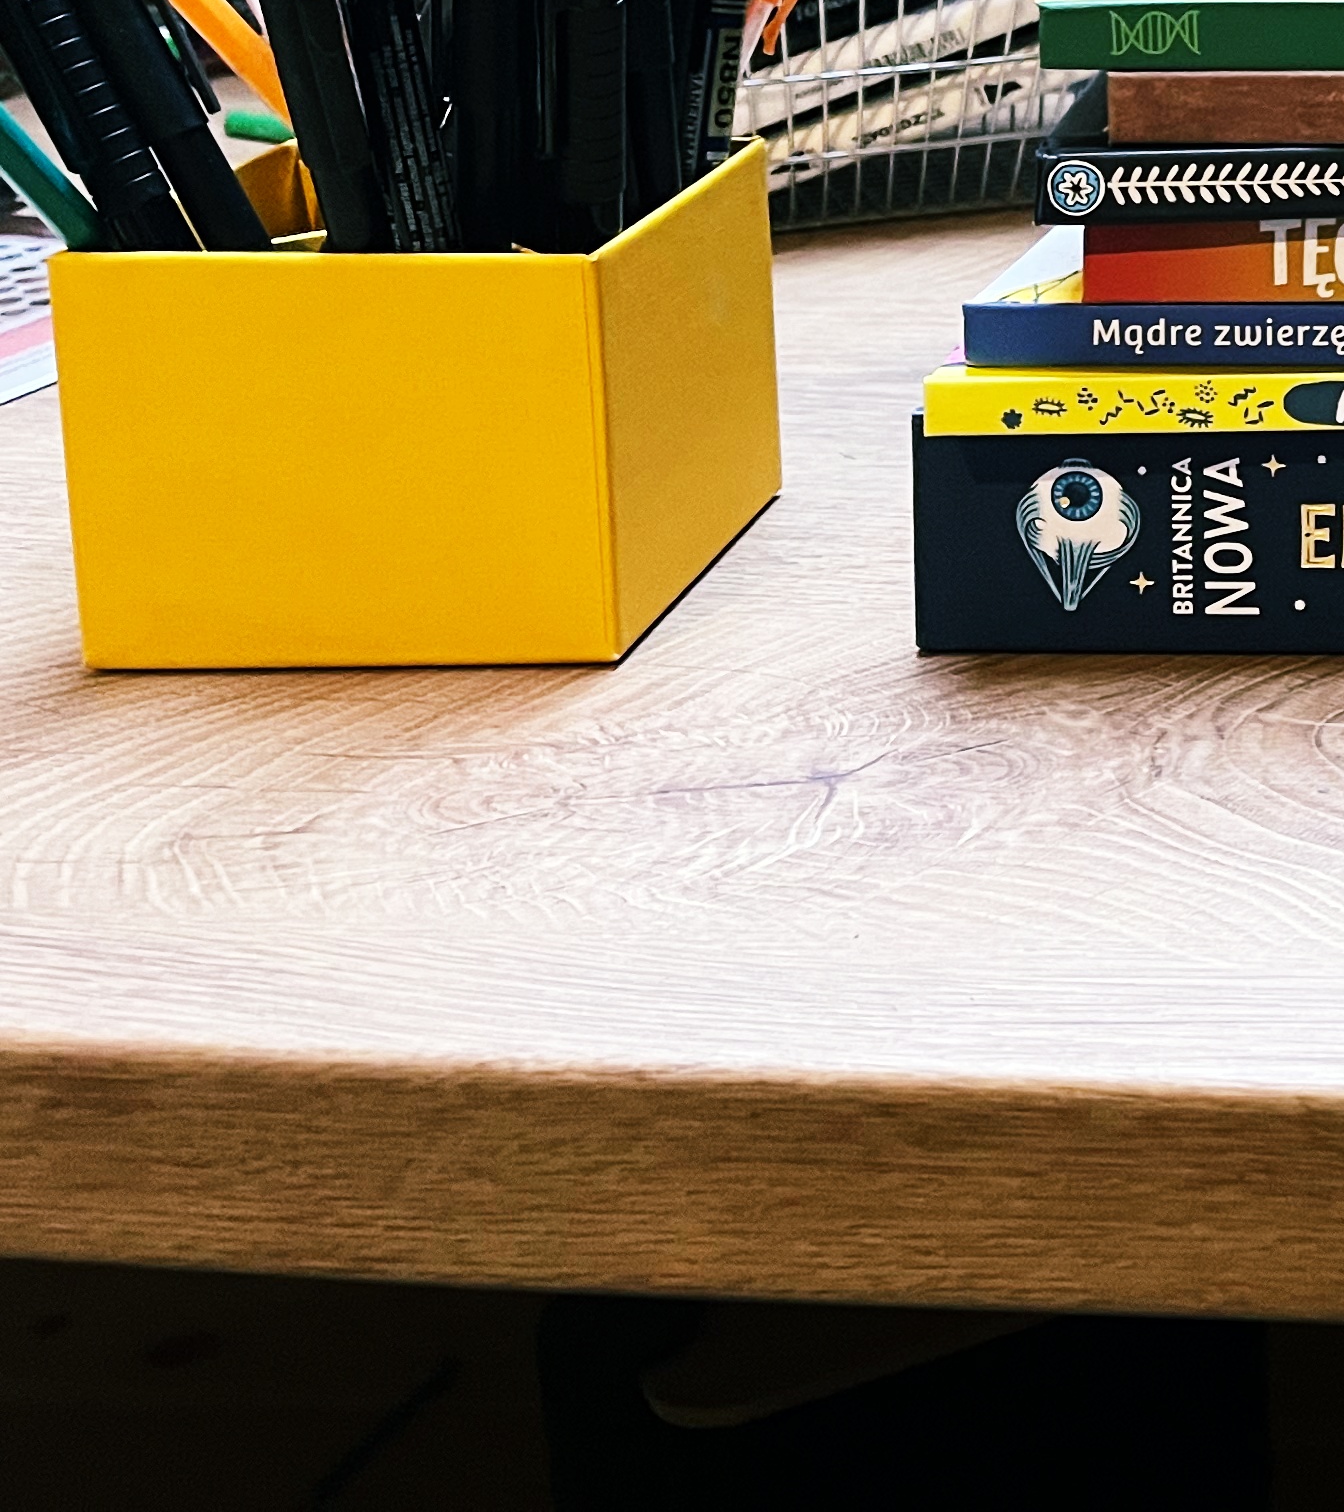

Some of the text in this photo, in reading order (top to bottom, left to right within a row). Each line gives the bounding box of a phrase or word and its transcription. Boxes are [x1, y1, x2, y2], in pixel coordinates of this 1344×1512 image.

[715, 36, 740, 128] N850
[1092, 317, 1202, 355] Mądre
[1170, 457, 1194, 615] BRITANNICA
[1203, 457, 1261, 616] NOWA
